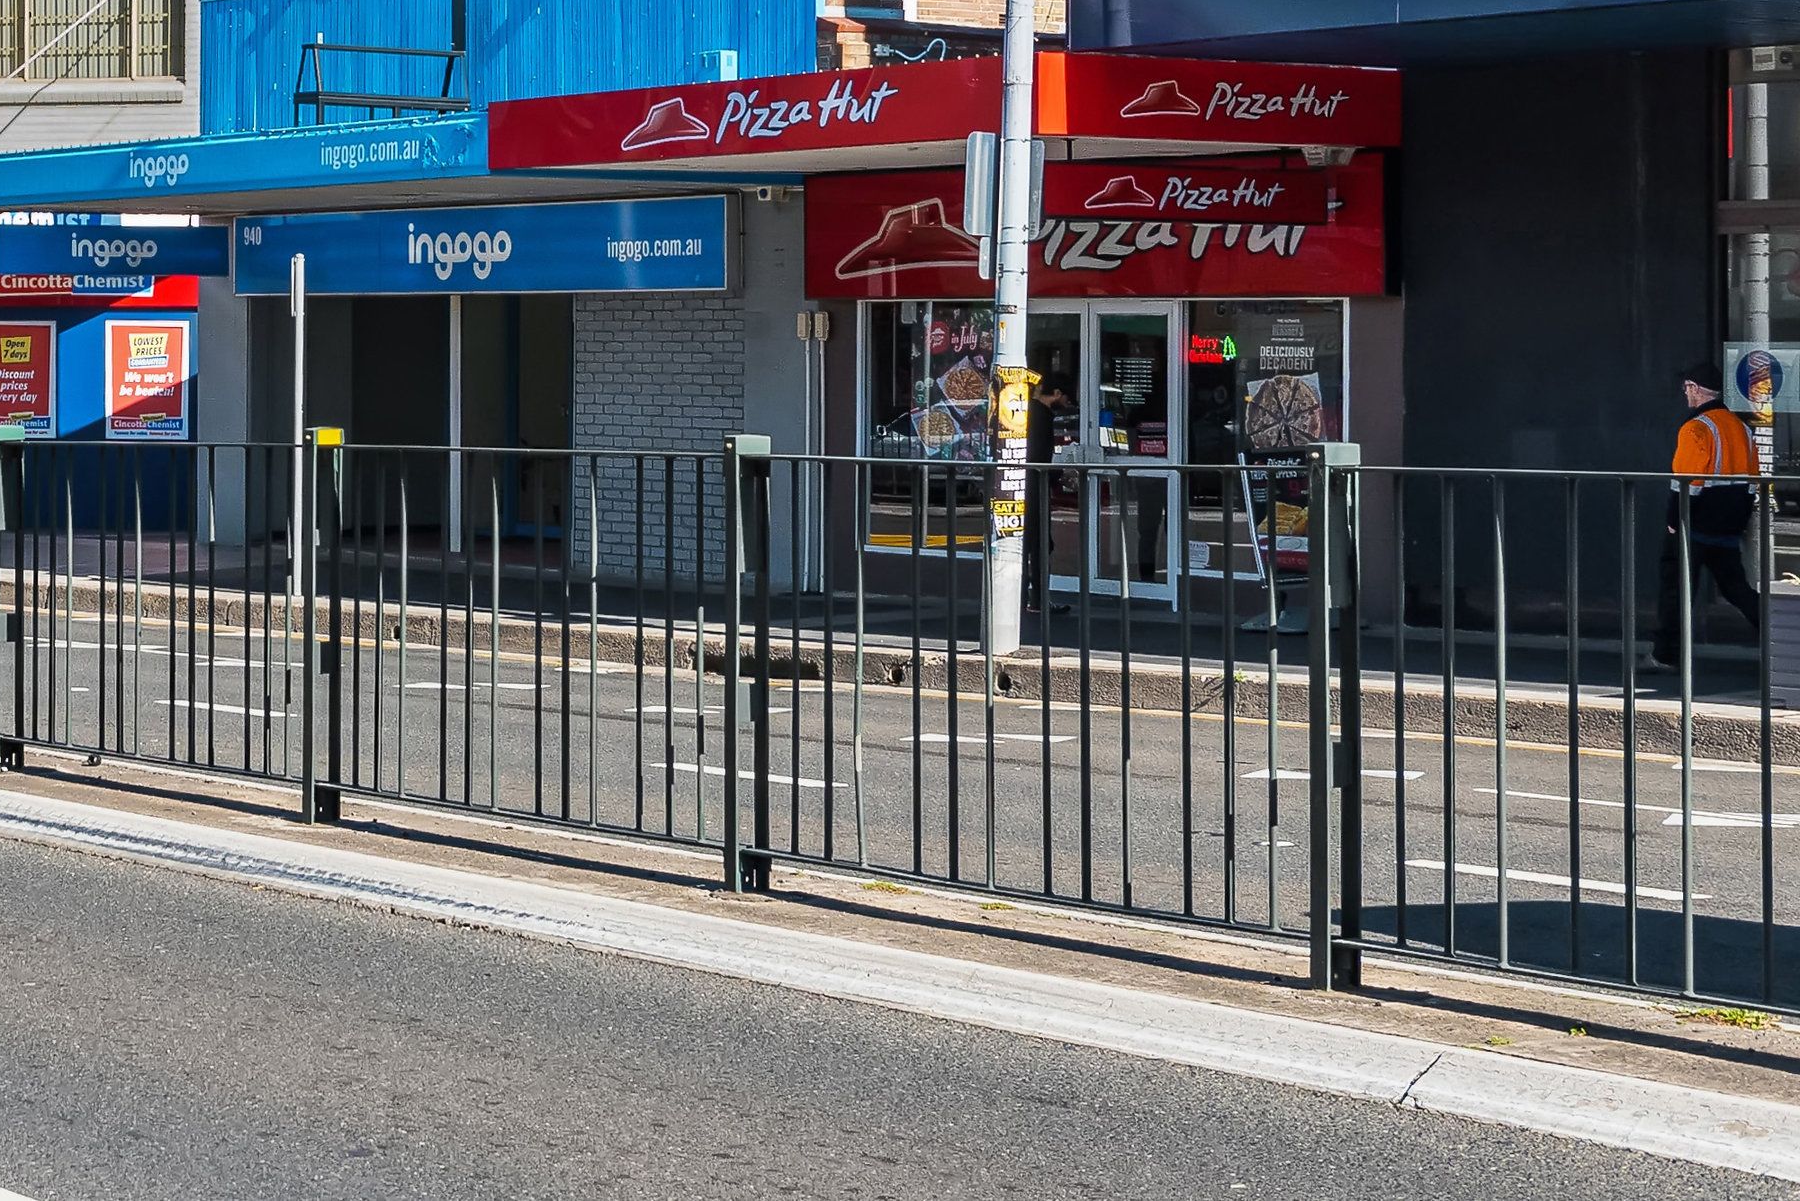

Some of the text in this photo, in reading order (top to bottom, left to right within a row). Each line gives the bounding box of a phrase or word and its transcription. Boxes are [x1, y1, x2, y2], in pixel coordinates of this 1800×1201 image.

[1206, 82, 1349, 120] Pizza Hut
[716, 79, 898, 144] Pizza Hut
[129, 151, 189, 187] ingogo
[321, 139, 420, 171] ingogo.com.au
[1159, 177, 1285, 210] Pizza Hut
[72, 232, 158, 267] ingogo
[244, 223, 702, 281] 940 ingogo ingogo.com.au
[133, 336, 164, 346] LOWEST
[955, 324, 978, 352] July
[5, 339, 25, 350] Open
[3, 348, 28, 360] 7 days
[135, 346, 162, 356] PRICES
[1260, 346, 1315, 357] DELICIOUSLY
[1260, 358, 1315, 370] DECADENT
[124, 372, 140, 383] We
[0, 381, 28, 392] prices
[20, 392, 37, 404] day
